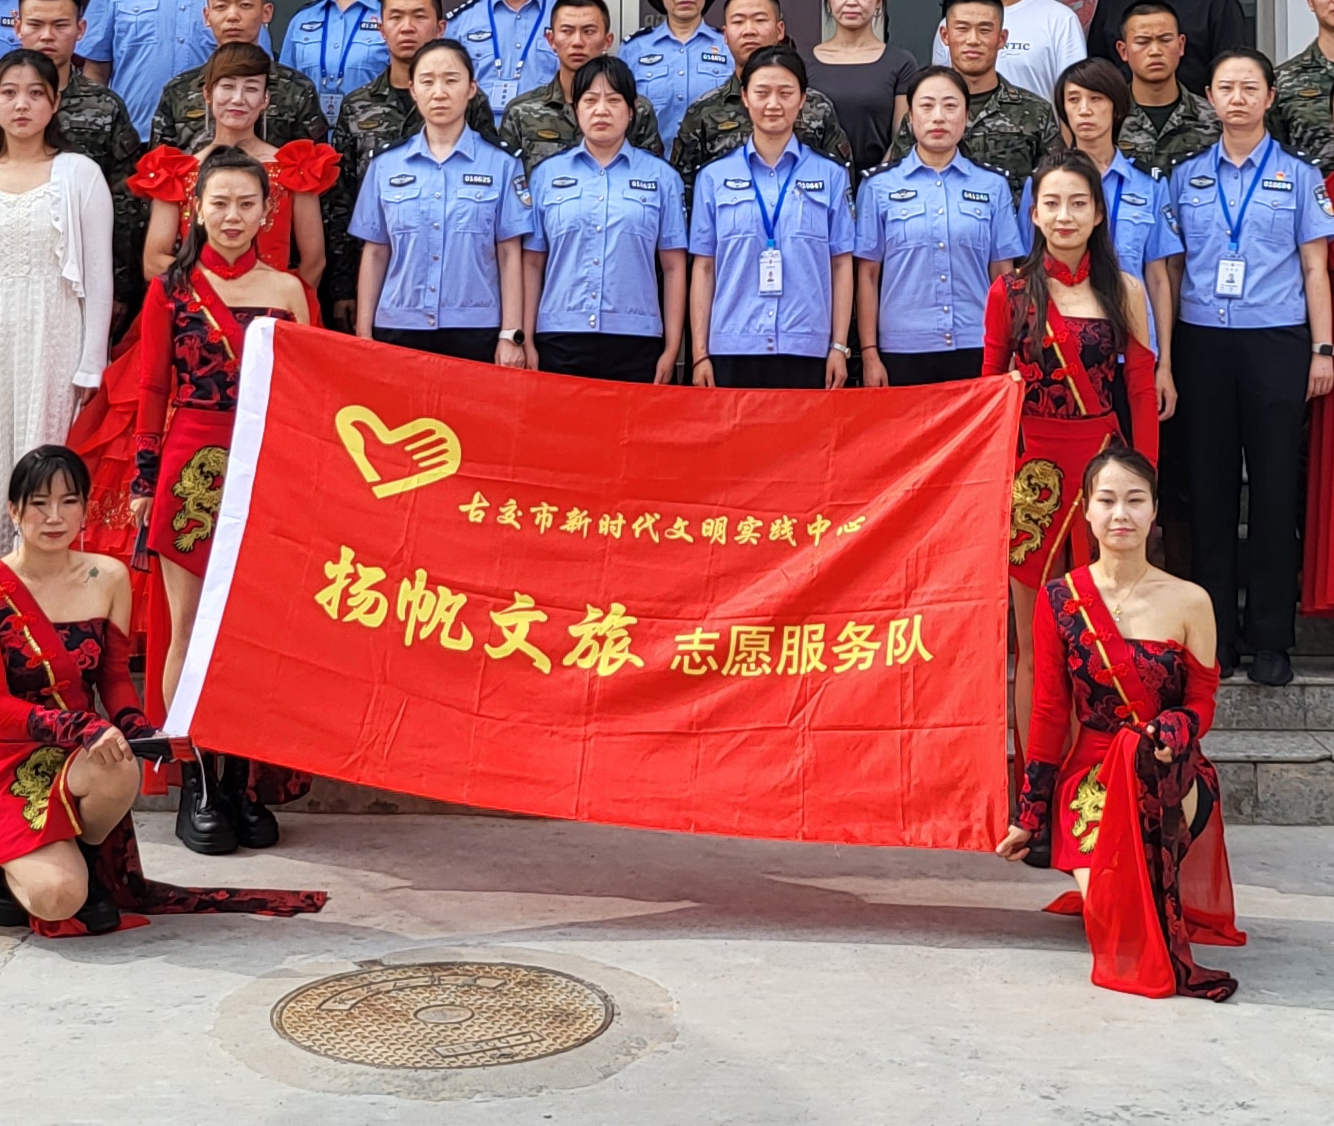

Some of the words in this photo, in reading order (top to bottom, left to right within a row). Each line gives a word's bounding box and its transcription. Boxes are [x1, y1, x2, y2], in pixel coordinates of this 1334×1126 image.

[458, 491, 870, 548] 古交市新时代文明实践中心
[314, 545, 645, 677] 扬帆文旅
[670, 614, 934, 677] 志愿服务队
